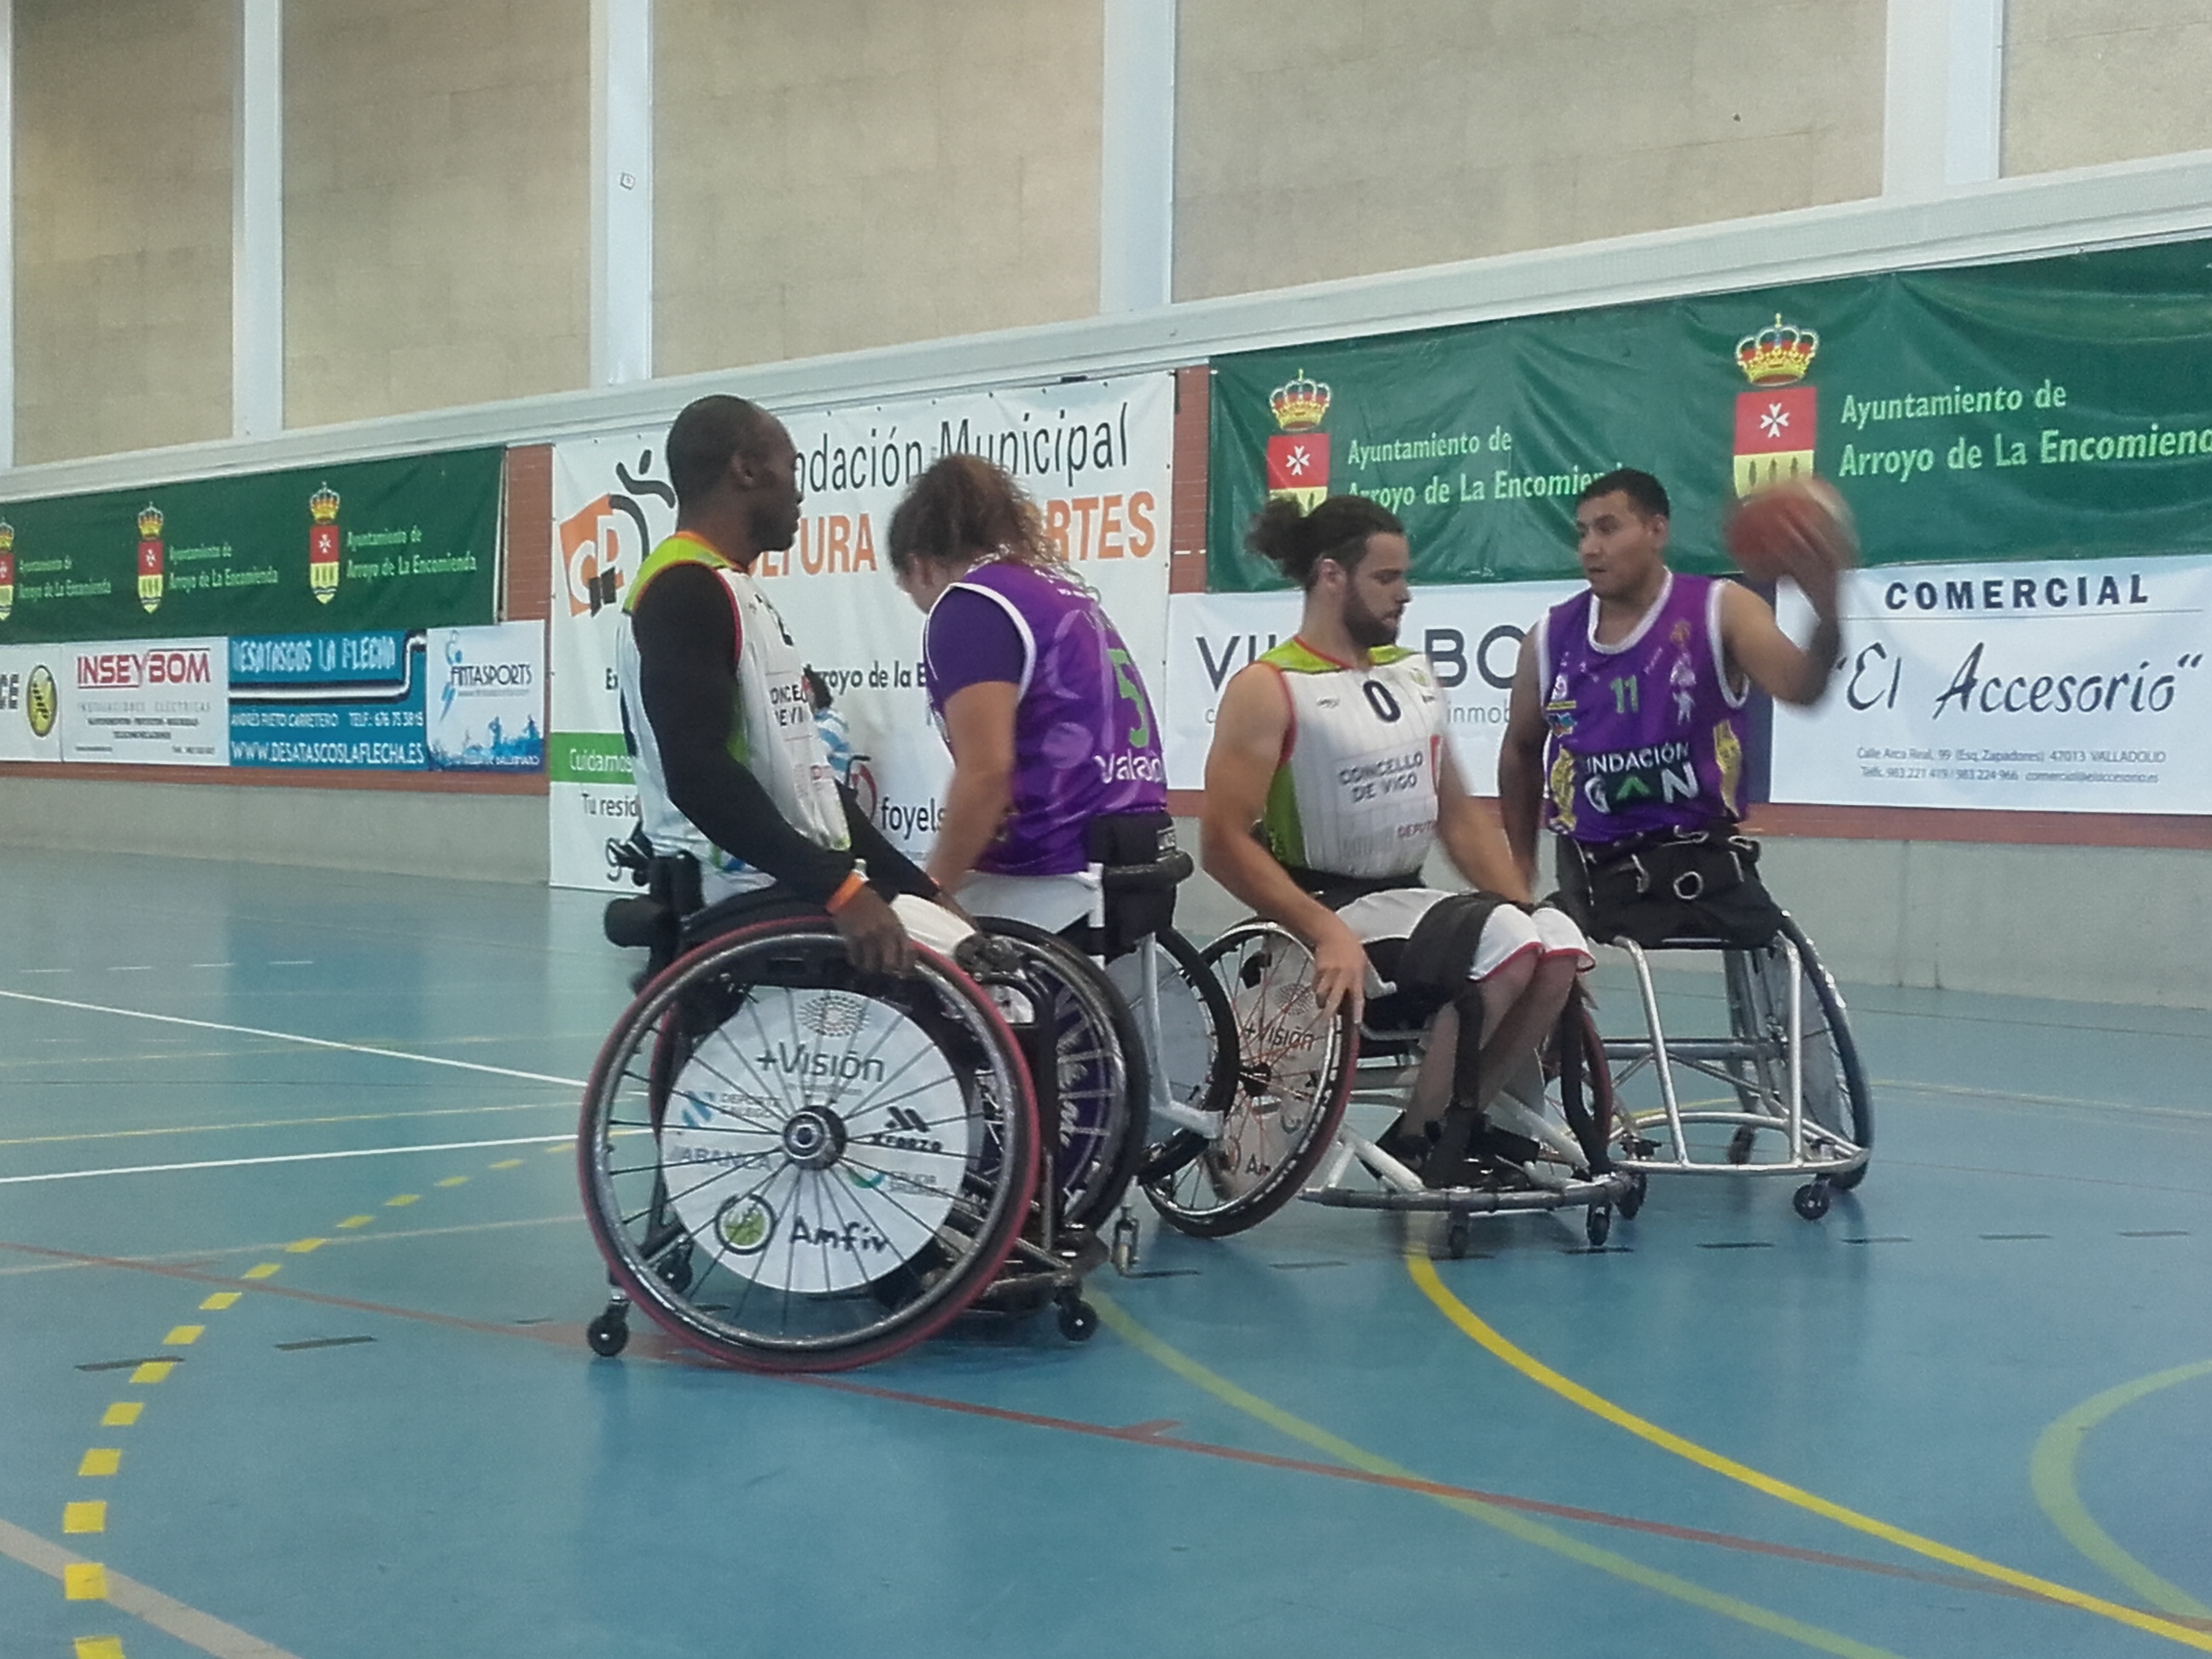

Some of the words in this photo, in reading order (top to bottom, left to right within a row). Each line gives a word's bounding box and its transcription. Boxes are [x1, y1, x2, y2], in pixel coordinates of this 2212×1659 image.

[1841, 384, 2023, 430] Ayuntamiento
[2035, 379, 2067, 409] de
[794, 426, 923, 492] ndación
[940, 402, 1129, 488] Municipal
[1348, 432, 1480, 470] Ayuntamiento
[1487, 425, 1512, 451] de
[1839, 443, 1935, 482] Arroyo
[1947, 437, 1982, 469] de
[1994, 433, 2028, 467] La
[1424, 475, 1450, 504] de
[1460, 473, 1485, 502] La
[1045, 492, 1155, 562] RTES
[1883, 573, 2150, 611] COMERCIAL
[77, 651, 211, 685] INSEYBOM
[870, 661, 890, 688] de
[894, 661, 911, 688] la
[1363, 679, 1401, 723] 0
[1610, 674, 1639, 714] 11
[1338, 750, 1423, 786] CONCELLO
[1351, 783, 1377, 804] DE
[789, 1215, 888, 1253] Amfiv
